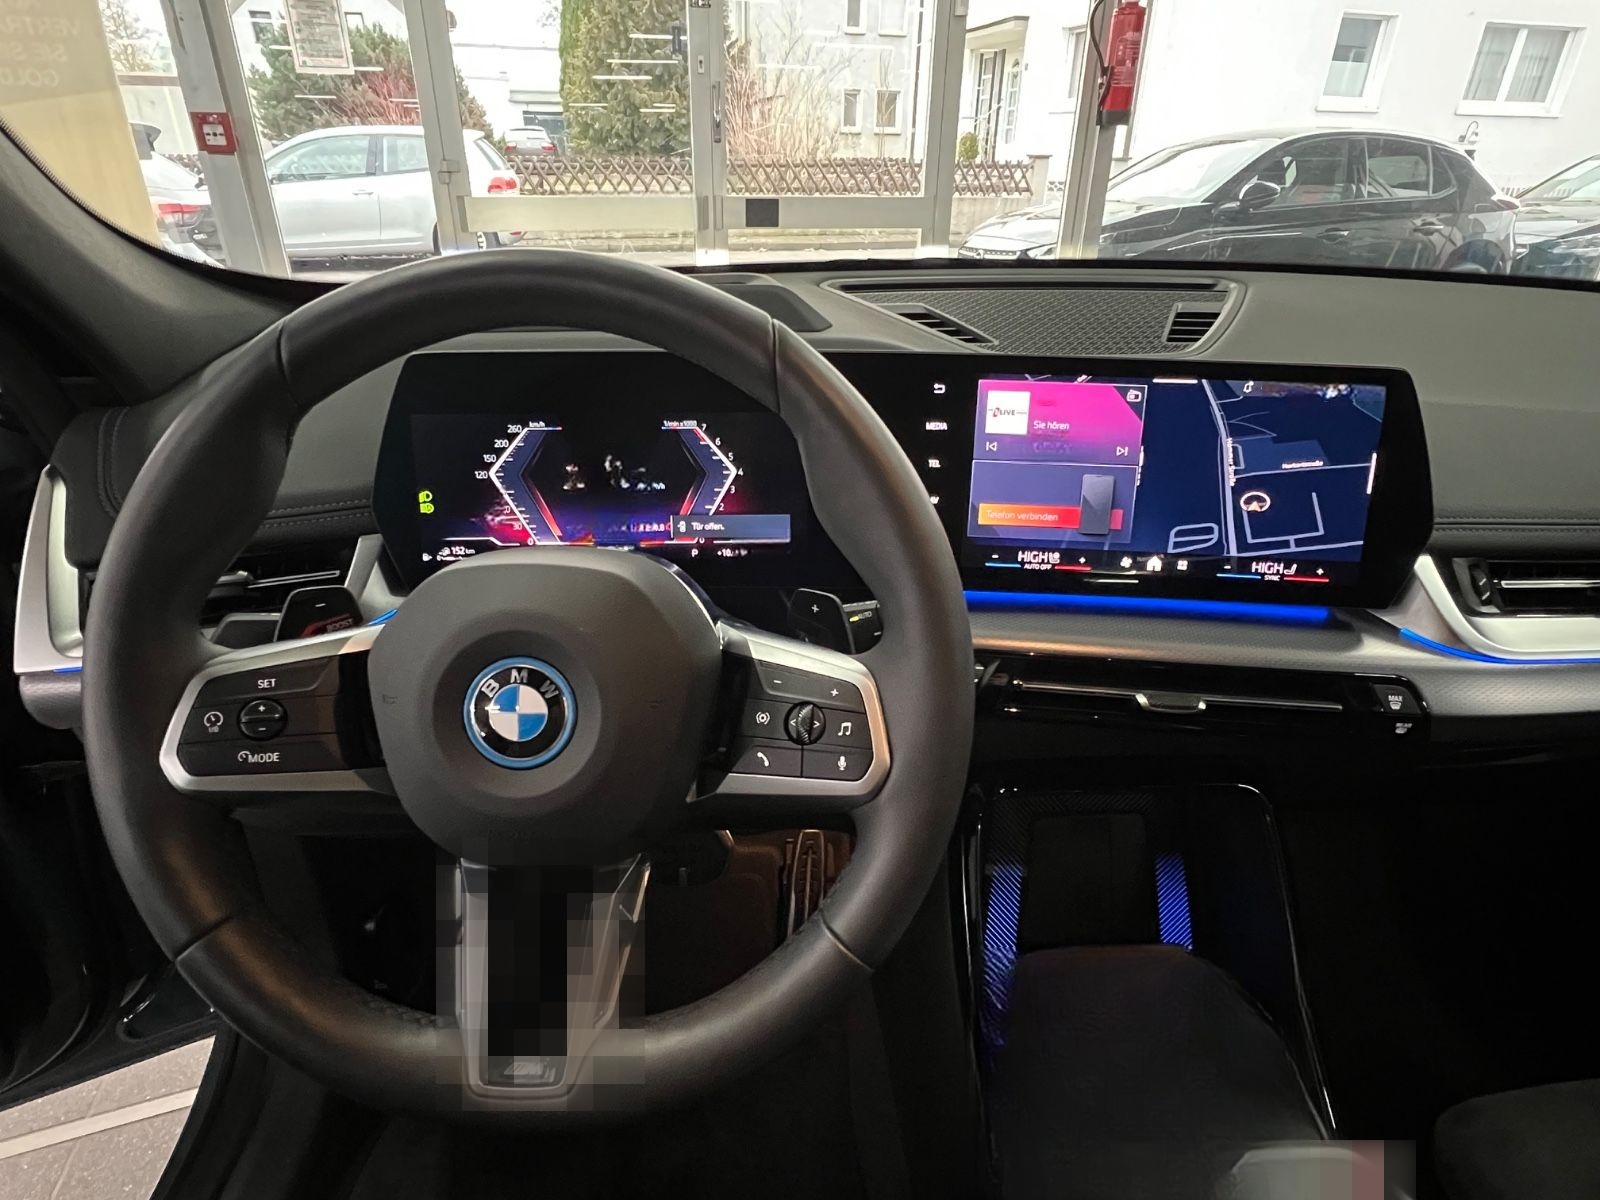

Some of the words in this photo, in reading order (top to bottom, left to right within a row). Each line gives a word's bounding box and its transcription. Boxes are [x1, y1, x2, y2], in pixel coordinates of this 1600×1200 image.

[507, 425, 522, 433] 260
[925, 422, 948, 430] MEDIA
[1033, 420, 1046, 429] Sie
[1047, 421, 1070, 430] hören
[494, 439, 509, 448] 200
[715, 437, 721, 445] 6
[483, 454, 496, 462] 150
[728, 452, 734, 461] 5
[475, 471, 488, 479] 120
[737, 468, 744, 476] 4
[730, 485, 736, 494] 3
[718, 502, 724, 511] 2
[986, 510, 1015, 519] Telefon
[1017, 511, 1059, 521] verbinden
[691, 522, 703, 530] Tür
[691, 549, 698, 557] P
[1018, 551, 1048, 563] HIGH
[1251, 561, 1284, 574] HIGH
[257, 678, 277, 689] SET
[481, 668, 559, 698] BMW
[248, 752, 280, 763] MODE
